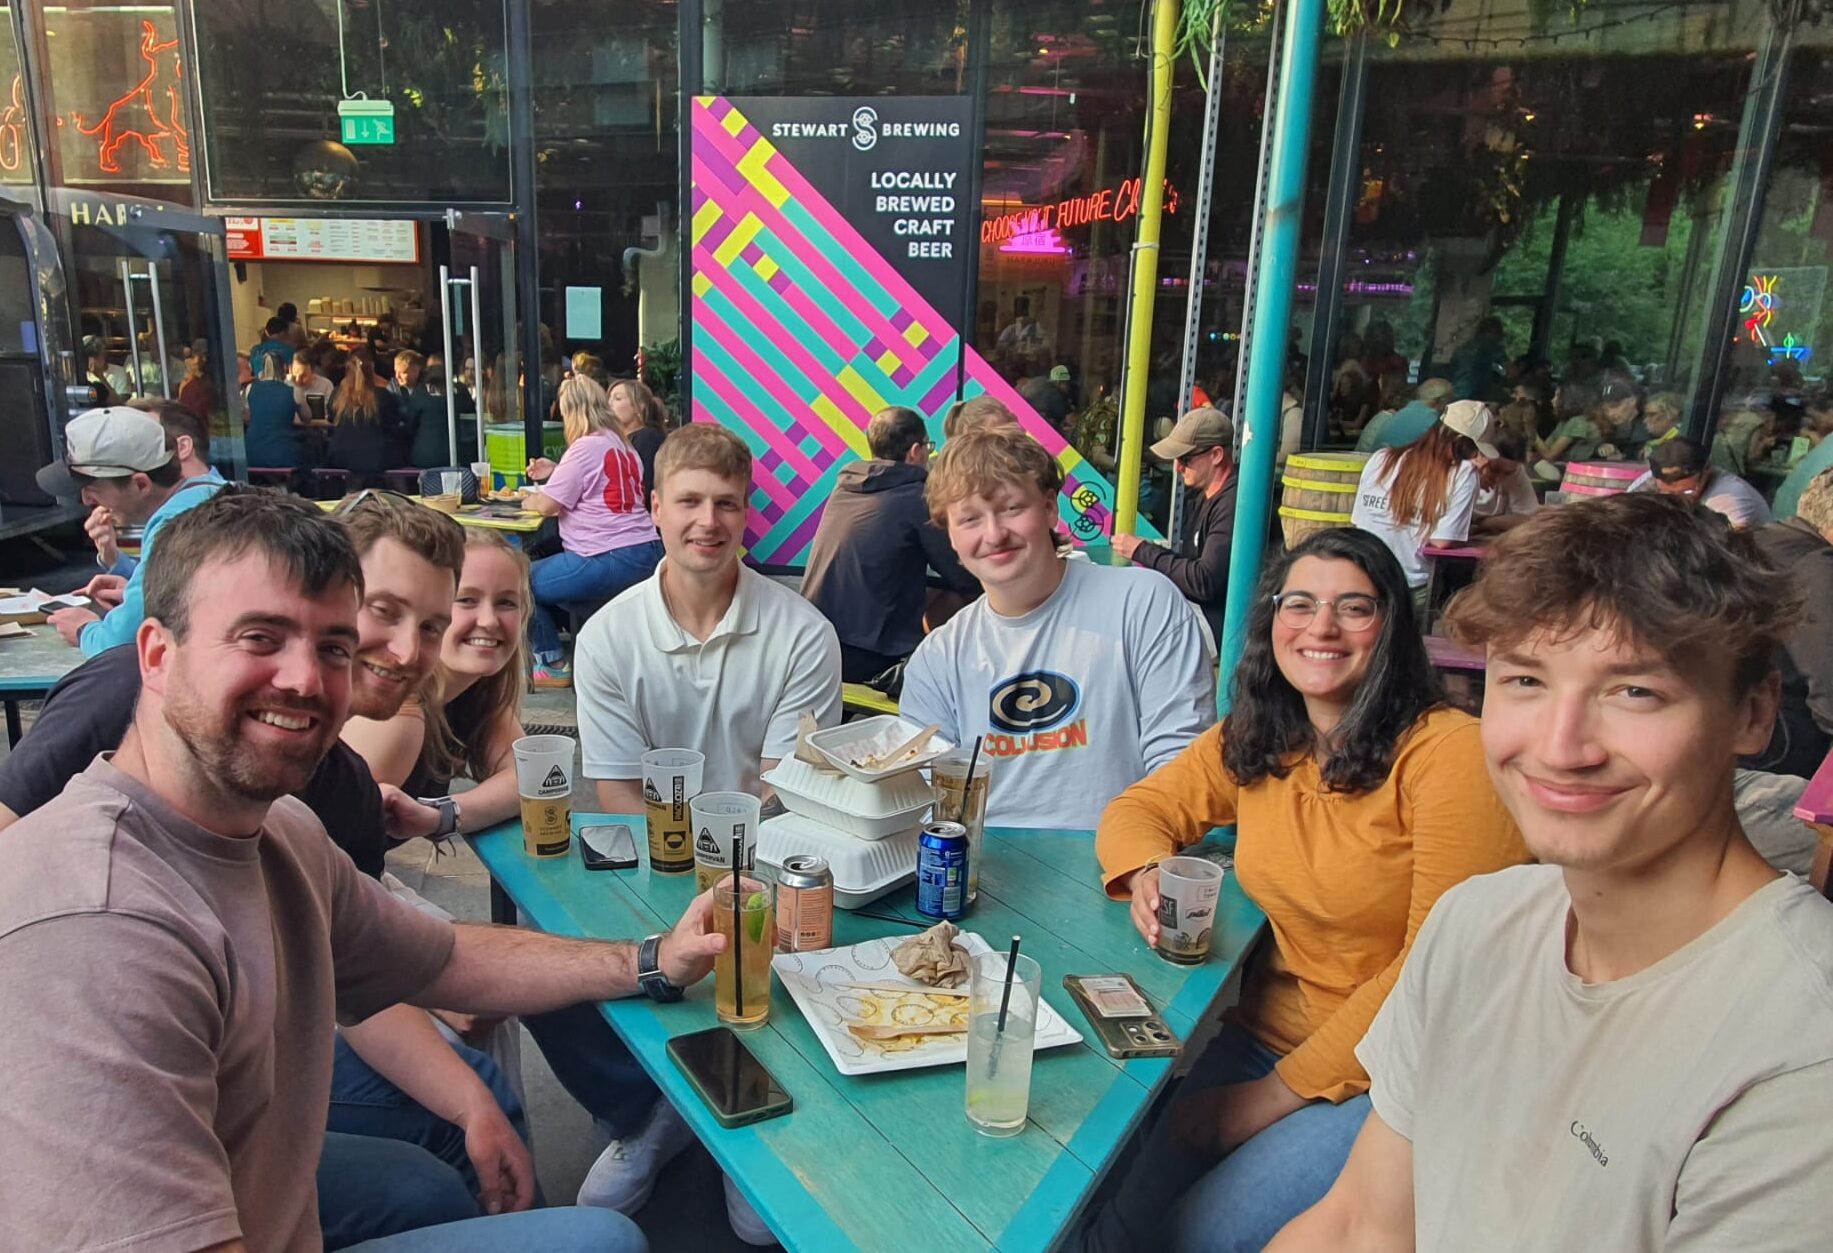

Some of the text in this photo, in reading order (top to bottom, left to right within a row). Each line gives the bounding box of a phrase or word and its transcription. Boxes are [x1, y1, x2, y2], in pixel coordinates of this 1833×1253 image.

[772, 123, 848, 137] STEWART
[882, 123, 960, 137] BREWING
[871, 172, 957, 189] LOCALLY
[875, 196, 955, 212] BREWED
[981, 212, 1024, 243] CHOOSE
[1056, 189, 1113, 229] FUTURE
[893, 219, 955, 235] CRAFT
[908, 242, 952, 258] BEER
